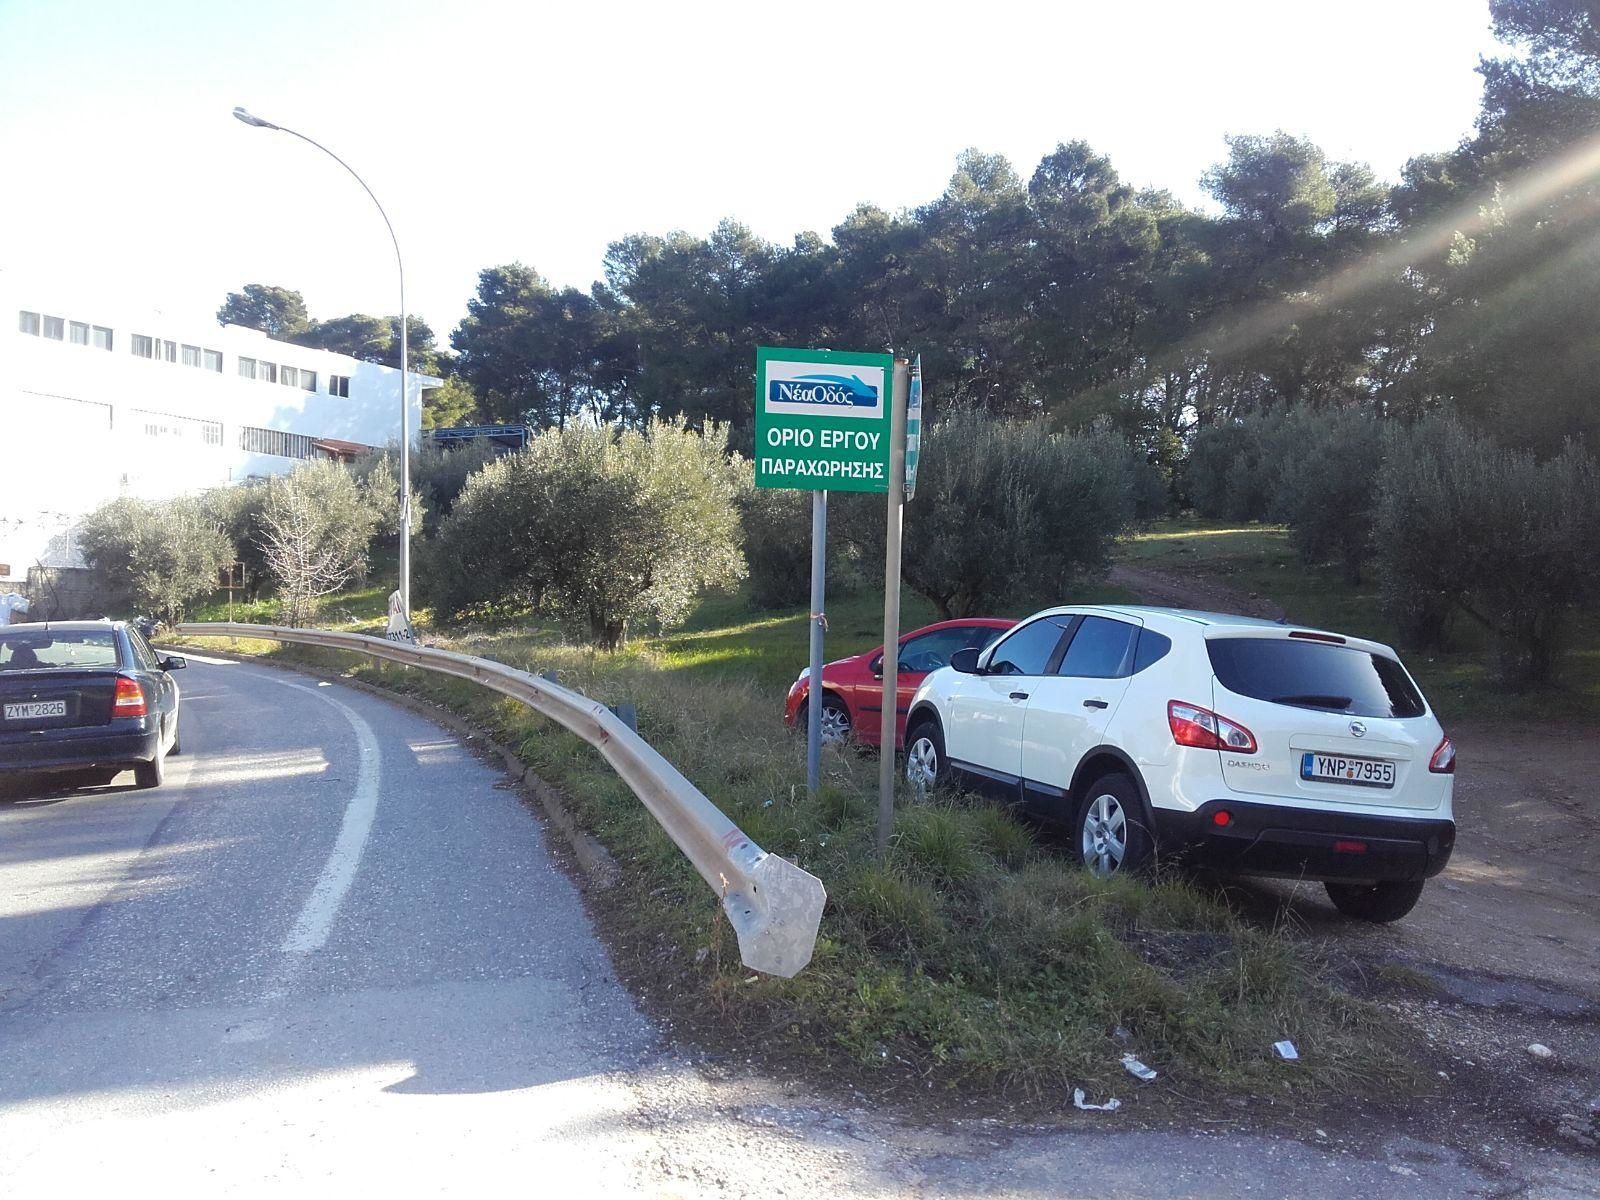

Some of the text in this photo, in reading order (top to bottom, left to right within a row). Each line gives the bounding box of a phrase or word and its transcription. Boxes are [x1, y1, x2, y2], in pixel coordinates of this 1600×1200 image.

[767, 427, 881, 450] ΟΡΙΟ ΕΡΓΟΥ
[761, 457, 884, 479] ΠΑΡΑΧΩΡΗΣΗΣ
